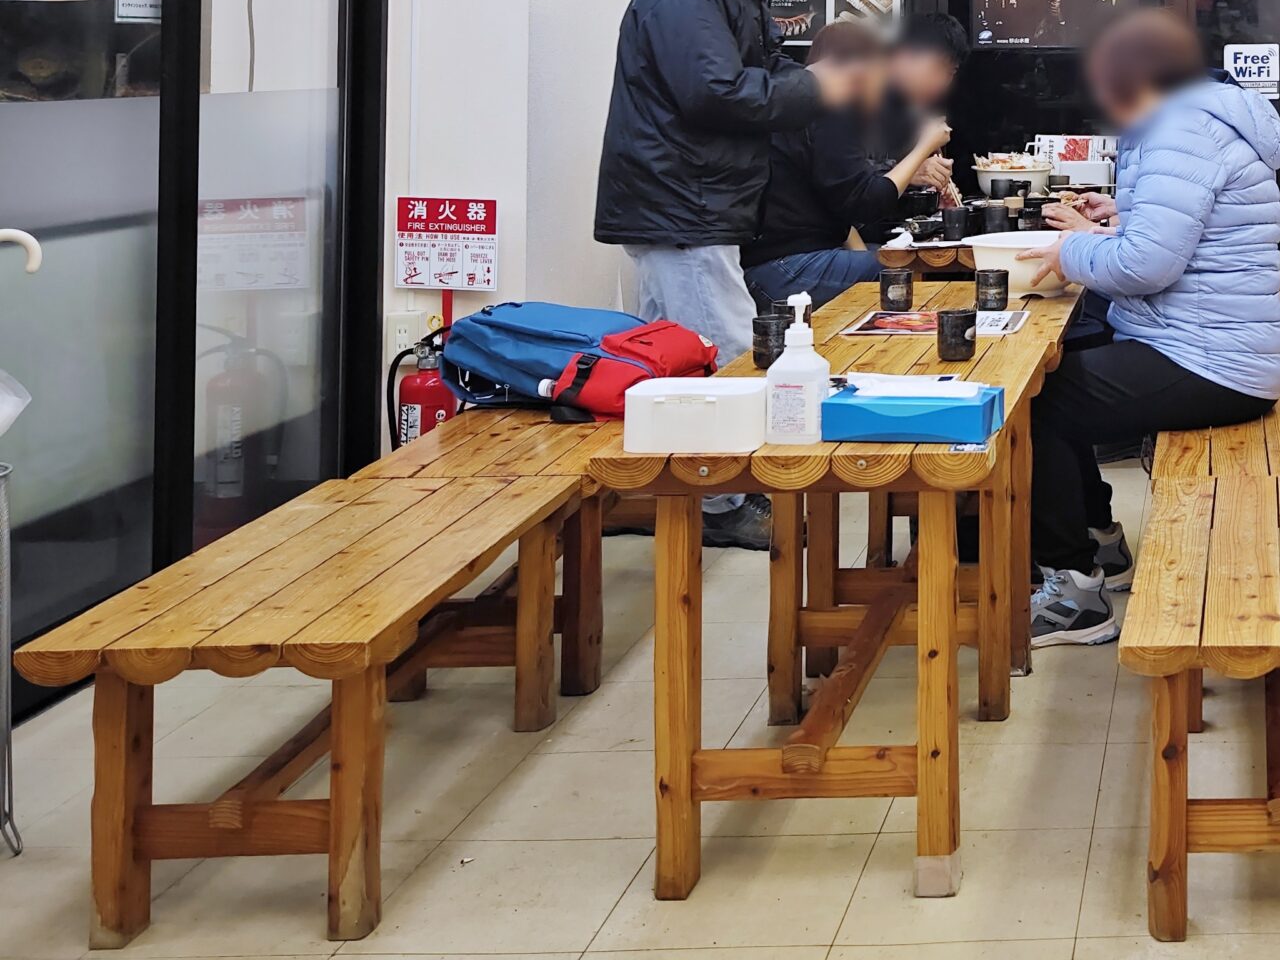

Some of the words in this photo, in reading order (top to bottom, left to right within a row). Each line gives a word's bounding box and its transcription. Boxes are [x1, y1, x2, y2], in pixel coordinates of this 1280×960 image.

[1233, 52, 1270, 64] Free
[1234, 66, 1270, 78] Wi-Fi
[407, 200, 487, 221] 消火器
[408, 222, 426, 230] FIRE
[429, 223, 486, 232] EXTINGUISHER
